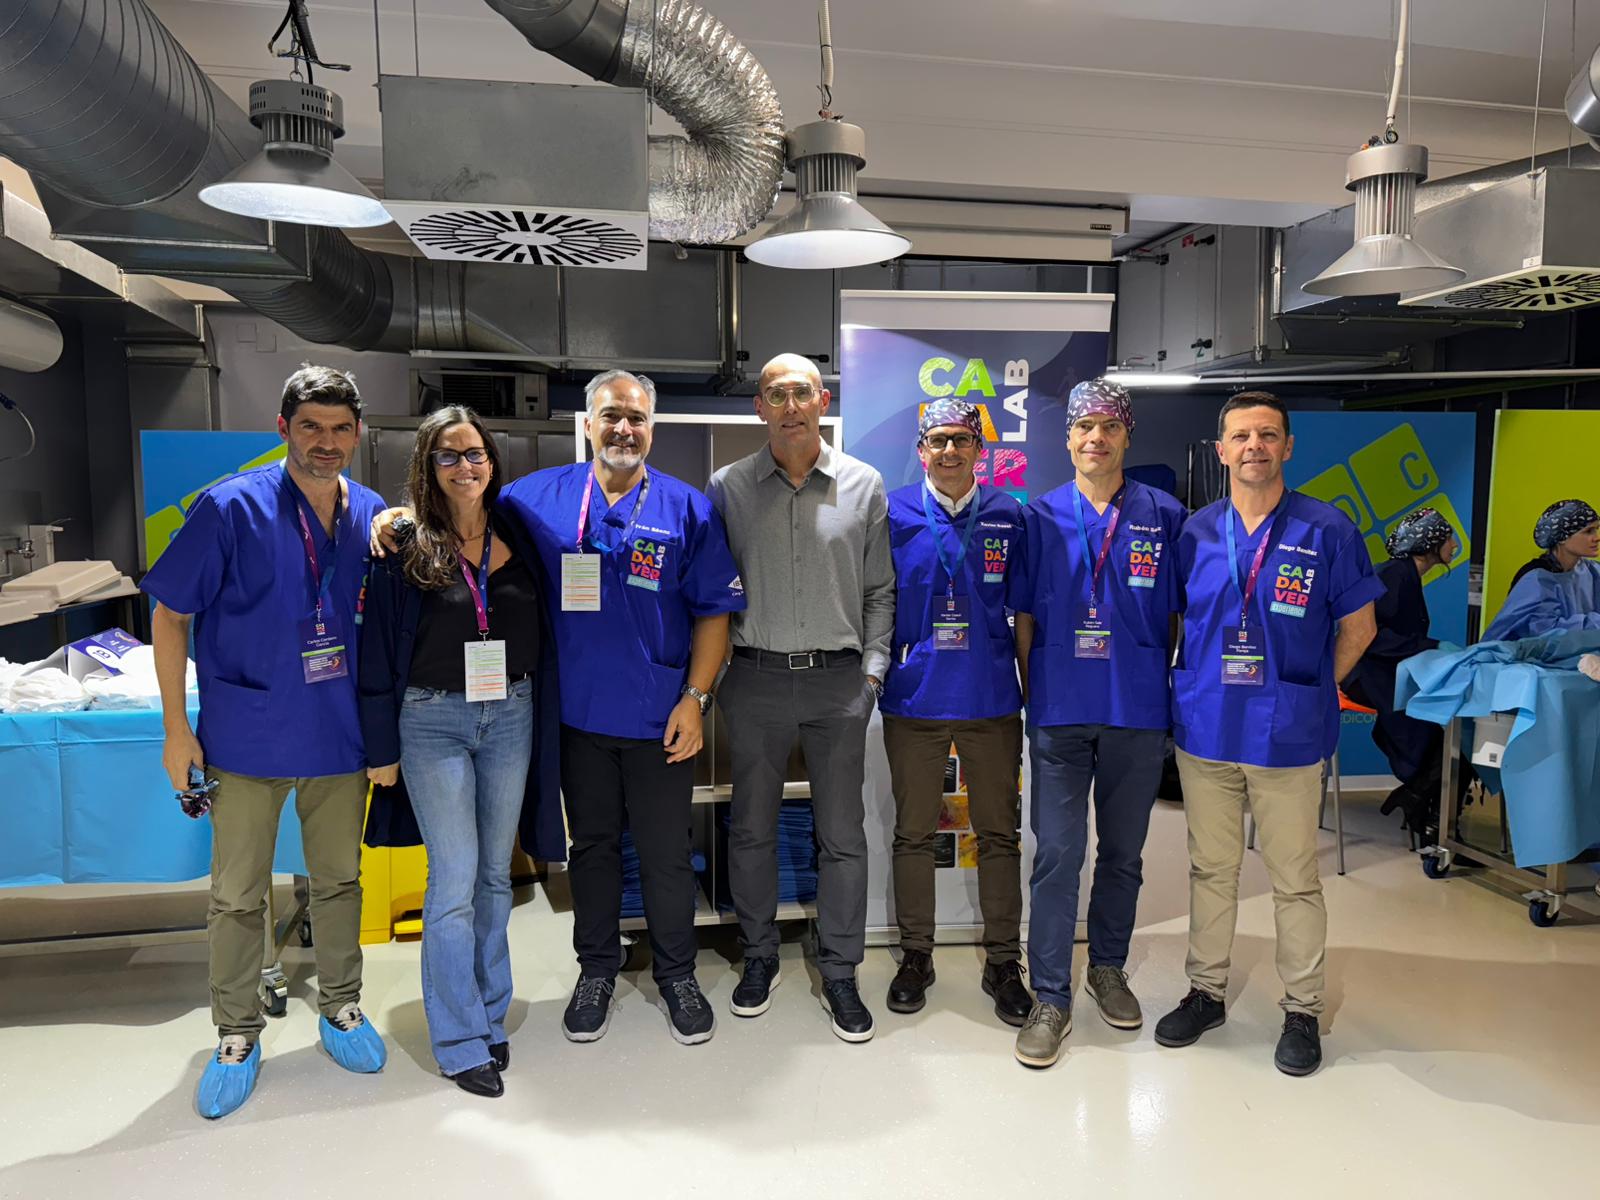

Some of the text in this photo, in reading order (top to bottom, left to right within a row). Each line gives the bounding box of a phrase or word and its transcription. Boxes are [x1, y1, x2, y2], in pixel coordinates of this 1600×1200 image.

[918, 357, 997, 397] CA
[1002, 359, 1029, 442] LAB
[633, 539, 656, 554] CA
[983, 538, 1002, 549] CA
[1131, 540, 1153, 552] CA
[1279, 543, 1296, 552] Diego
[631, 550, 655, 567] DA
[654, 545, 666, 569] LAB
[984, 550, 1002, 561] DA
[1130, 551, 1153, 565] DA
[630, 563, 660, 581] VER
[1278, 563, 1304, 579] CA
[1275, 576, 1302, 592] DA
[1302, 568, 1315, 594] LAB
[1274, 588, 1309, 606] VER
